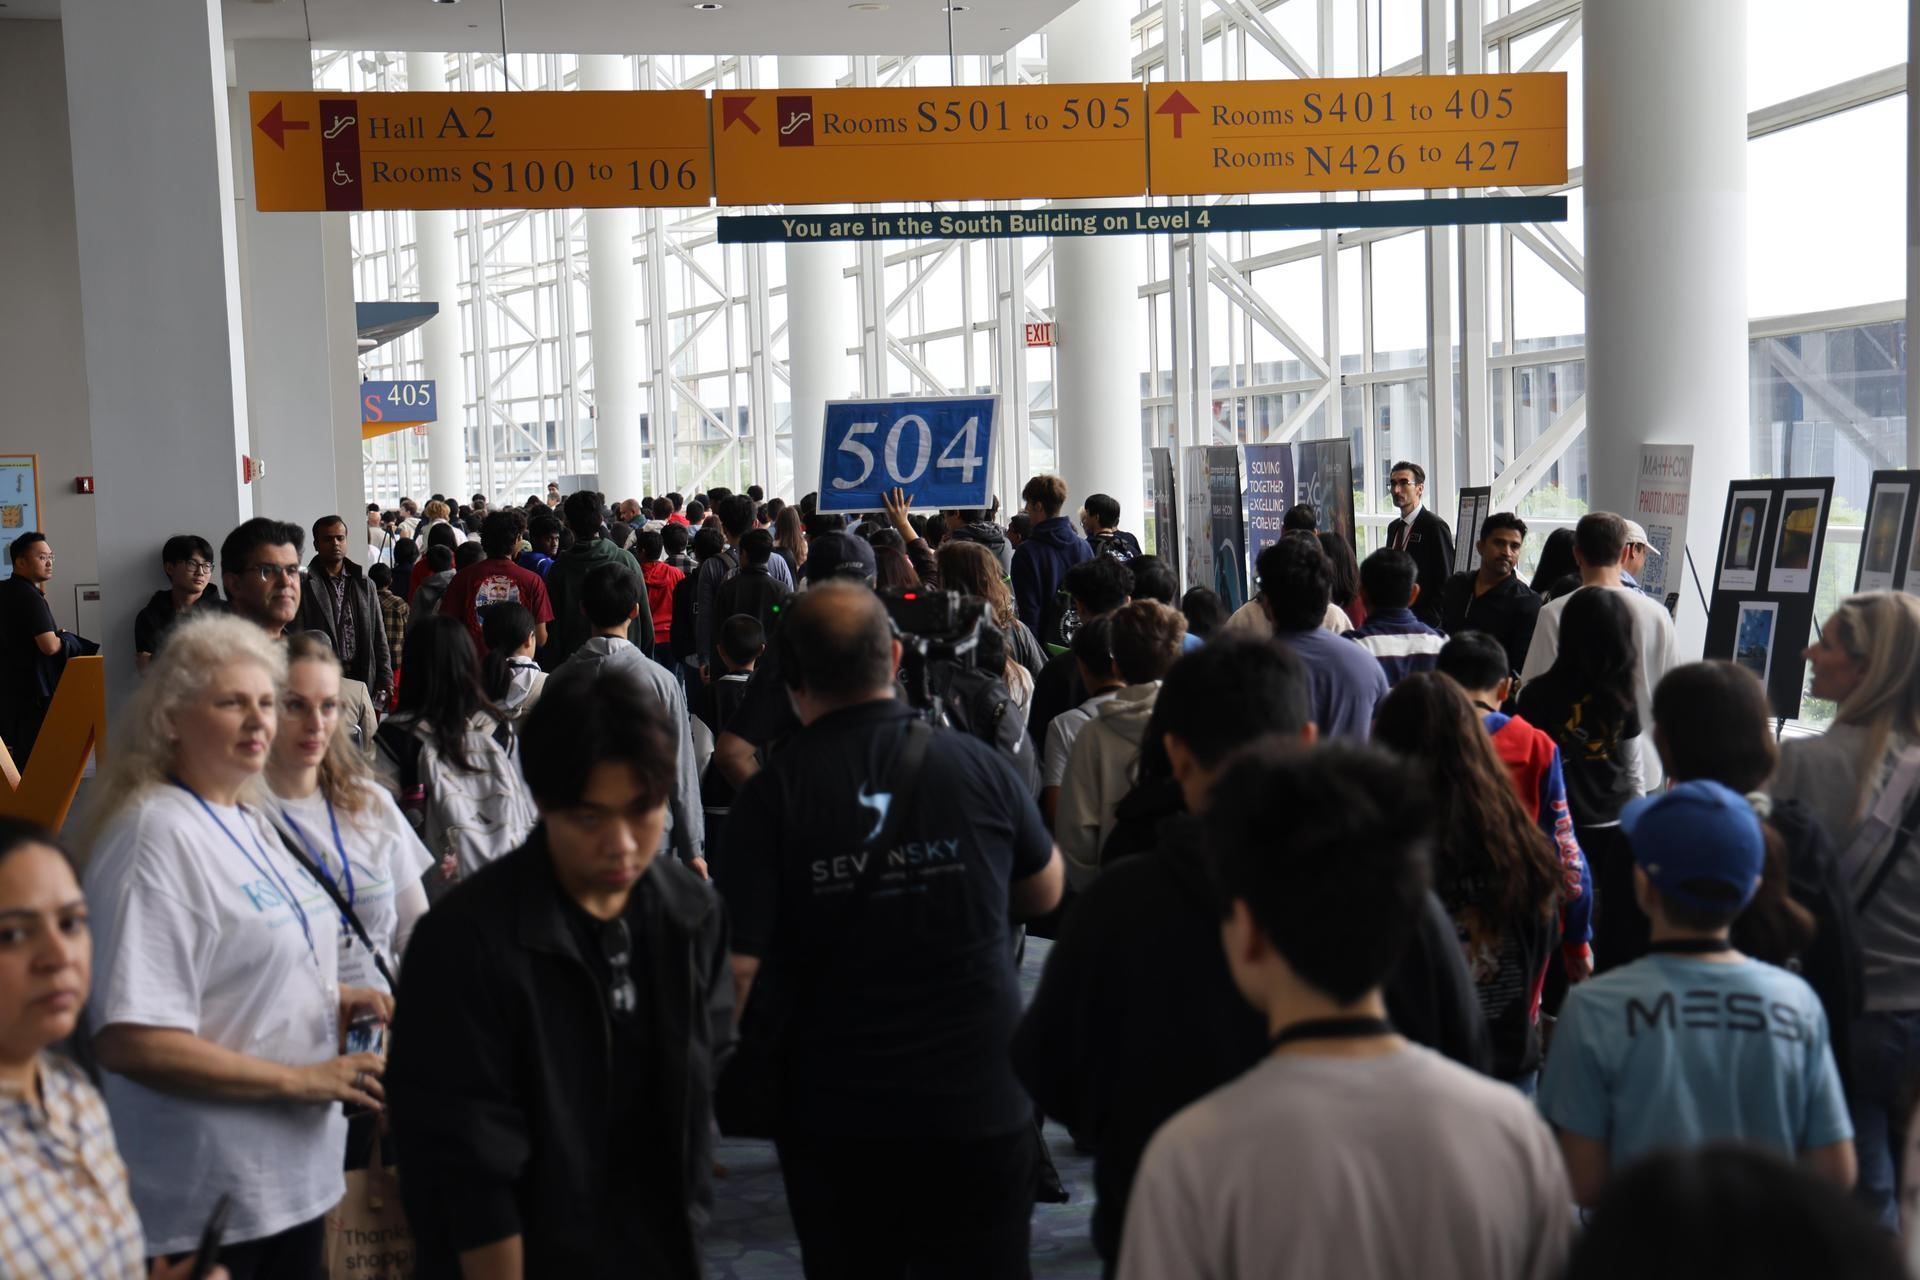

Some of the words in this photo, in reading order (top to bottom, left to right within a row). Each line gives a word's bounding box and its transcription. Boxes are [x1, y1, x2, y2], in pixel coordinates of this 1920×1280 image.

[369, 116, 424, 139] Hall
[436, 107, 496, 139] A2
[823, 112, 908, 134] Rooms
[917, 100, 1010, 133] S501
[1024, 112, 1049, 130] to
[1062, 97, 1131, 130] 505
[1212, 105, 1294, 126] Rooms
[1303, 91, 1395, 124] S401
[1410, 103, 1433, 121] to
[1445, 87, 1514, 120] 405
[372, 160, 462, 183] Rooms
[472, 160, 575, 194] S100
[588, 162, 614, 181] to
[628, 158, 697, 191] 106
[1213, 147, 1295, 168] Rooms
[1304, 144, 1406, 177] N426
[1419, 145, 1442, 162] to
[1455, 140, 1521, 172] 427
[782, 219, 822, 238] You
[829, 220, 864, 237] are
[871, 217, 891, 236] in
[897, 216, 933, 236] the
[939, 214, 1001, 235] South
[1009, 214, 1097, 236] Building
[1103, 216, 1129, 232] on
[1135, 210, 1190, 231] Level
[1196, 210, 1211, 229] 4
[1025, 323, 1050, 343] EXIT
[364, 394, 384, 423] S
[387, 384, 430, 406] 405
[831, 414, 983, 490] 504
[1251, 461, 1280, 475] SOLVING
[1639, 490, 1662, 513] PHOTO
[1662, 491, 1688, 516] CONTEST
[811, 838, 960, 882] SEVNSKY
